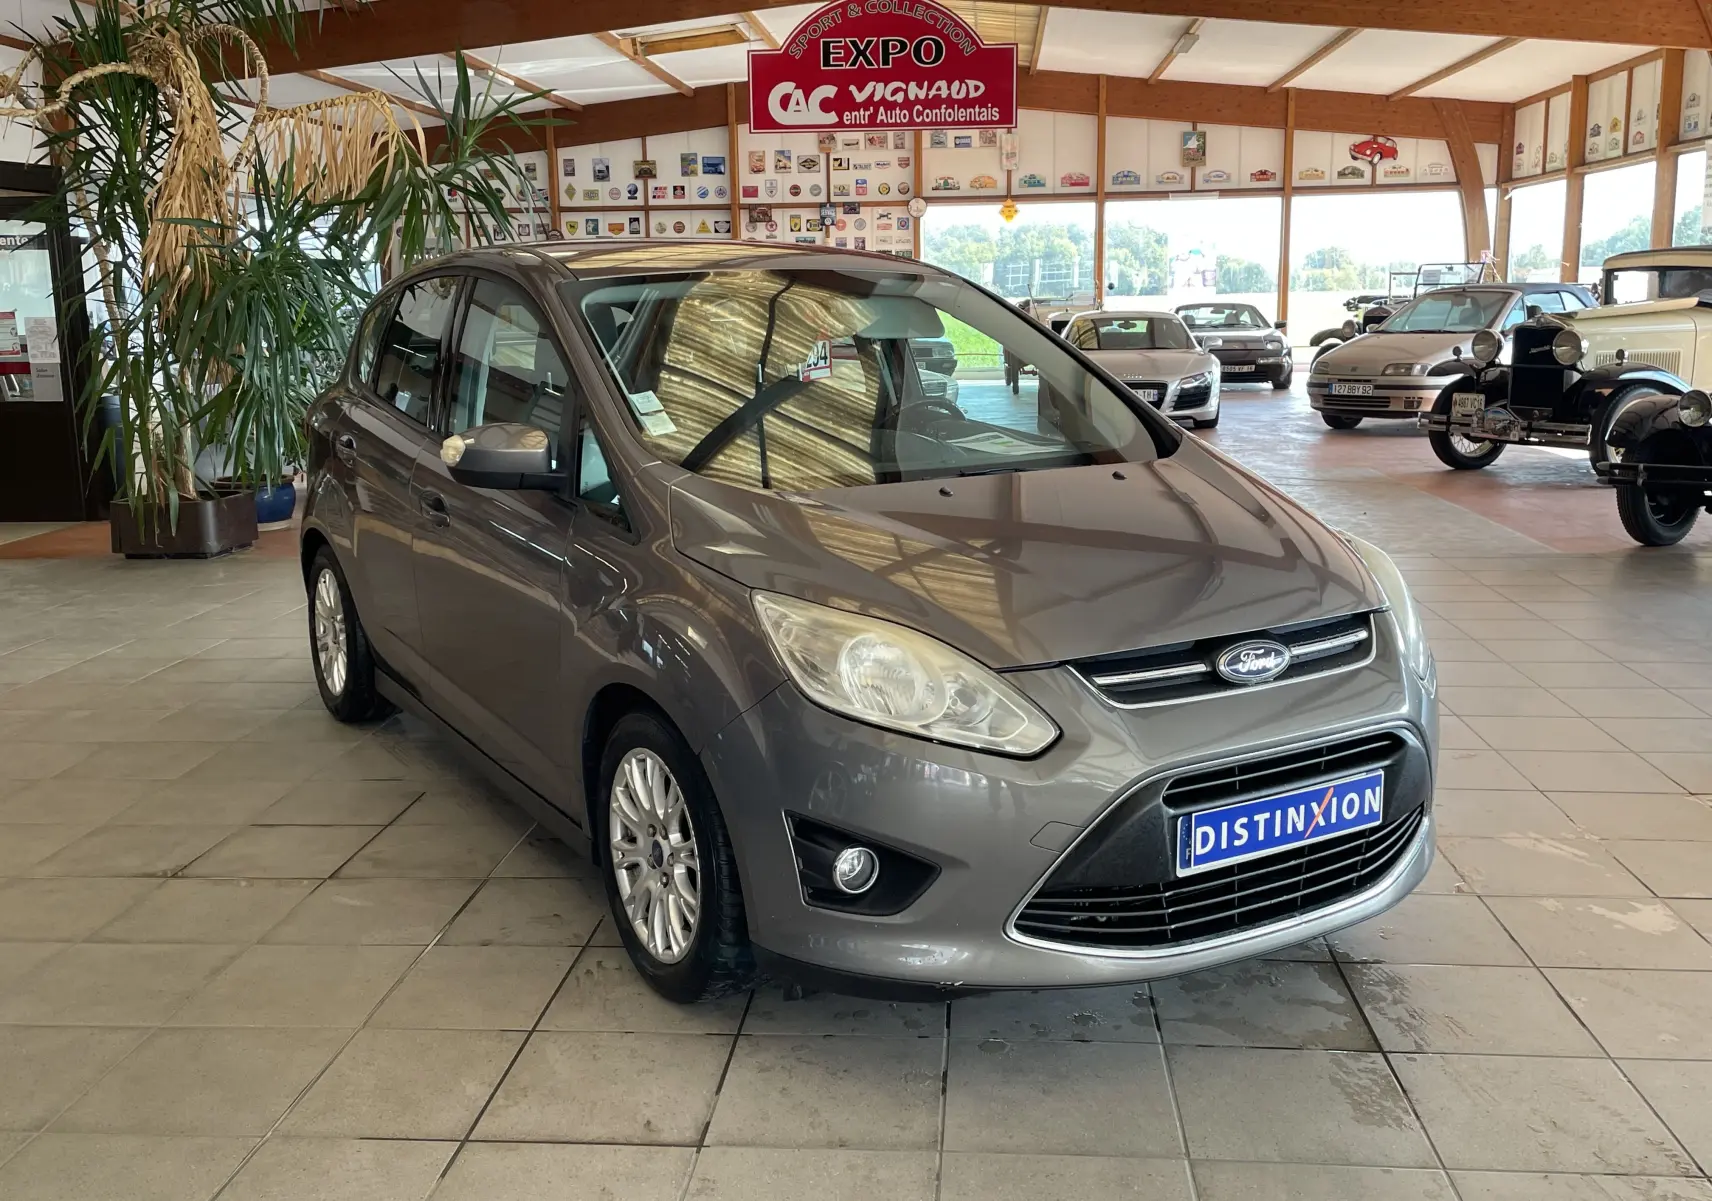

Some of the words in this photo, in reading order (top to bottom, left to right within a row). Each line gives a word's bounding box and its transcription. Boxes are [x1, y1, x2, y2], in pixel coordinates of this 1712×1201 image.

[788, 8, 842, 59] SPORT
[847, 3, 862, 18] &
[865, 0, 976, 56] COLLECTION
[820, 35, 946, 70] EXPO
[768, 81, 840, 126] CAC
[848, 79, 986, 103] VIGNAUD
[876, 106, 909, 123] Auto
[913, 103, 1000, 122] Confolentais
[1238, 648, 1275, 672] Ford
[1195, 786, 1380, 856] DISTINXION
